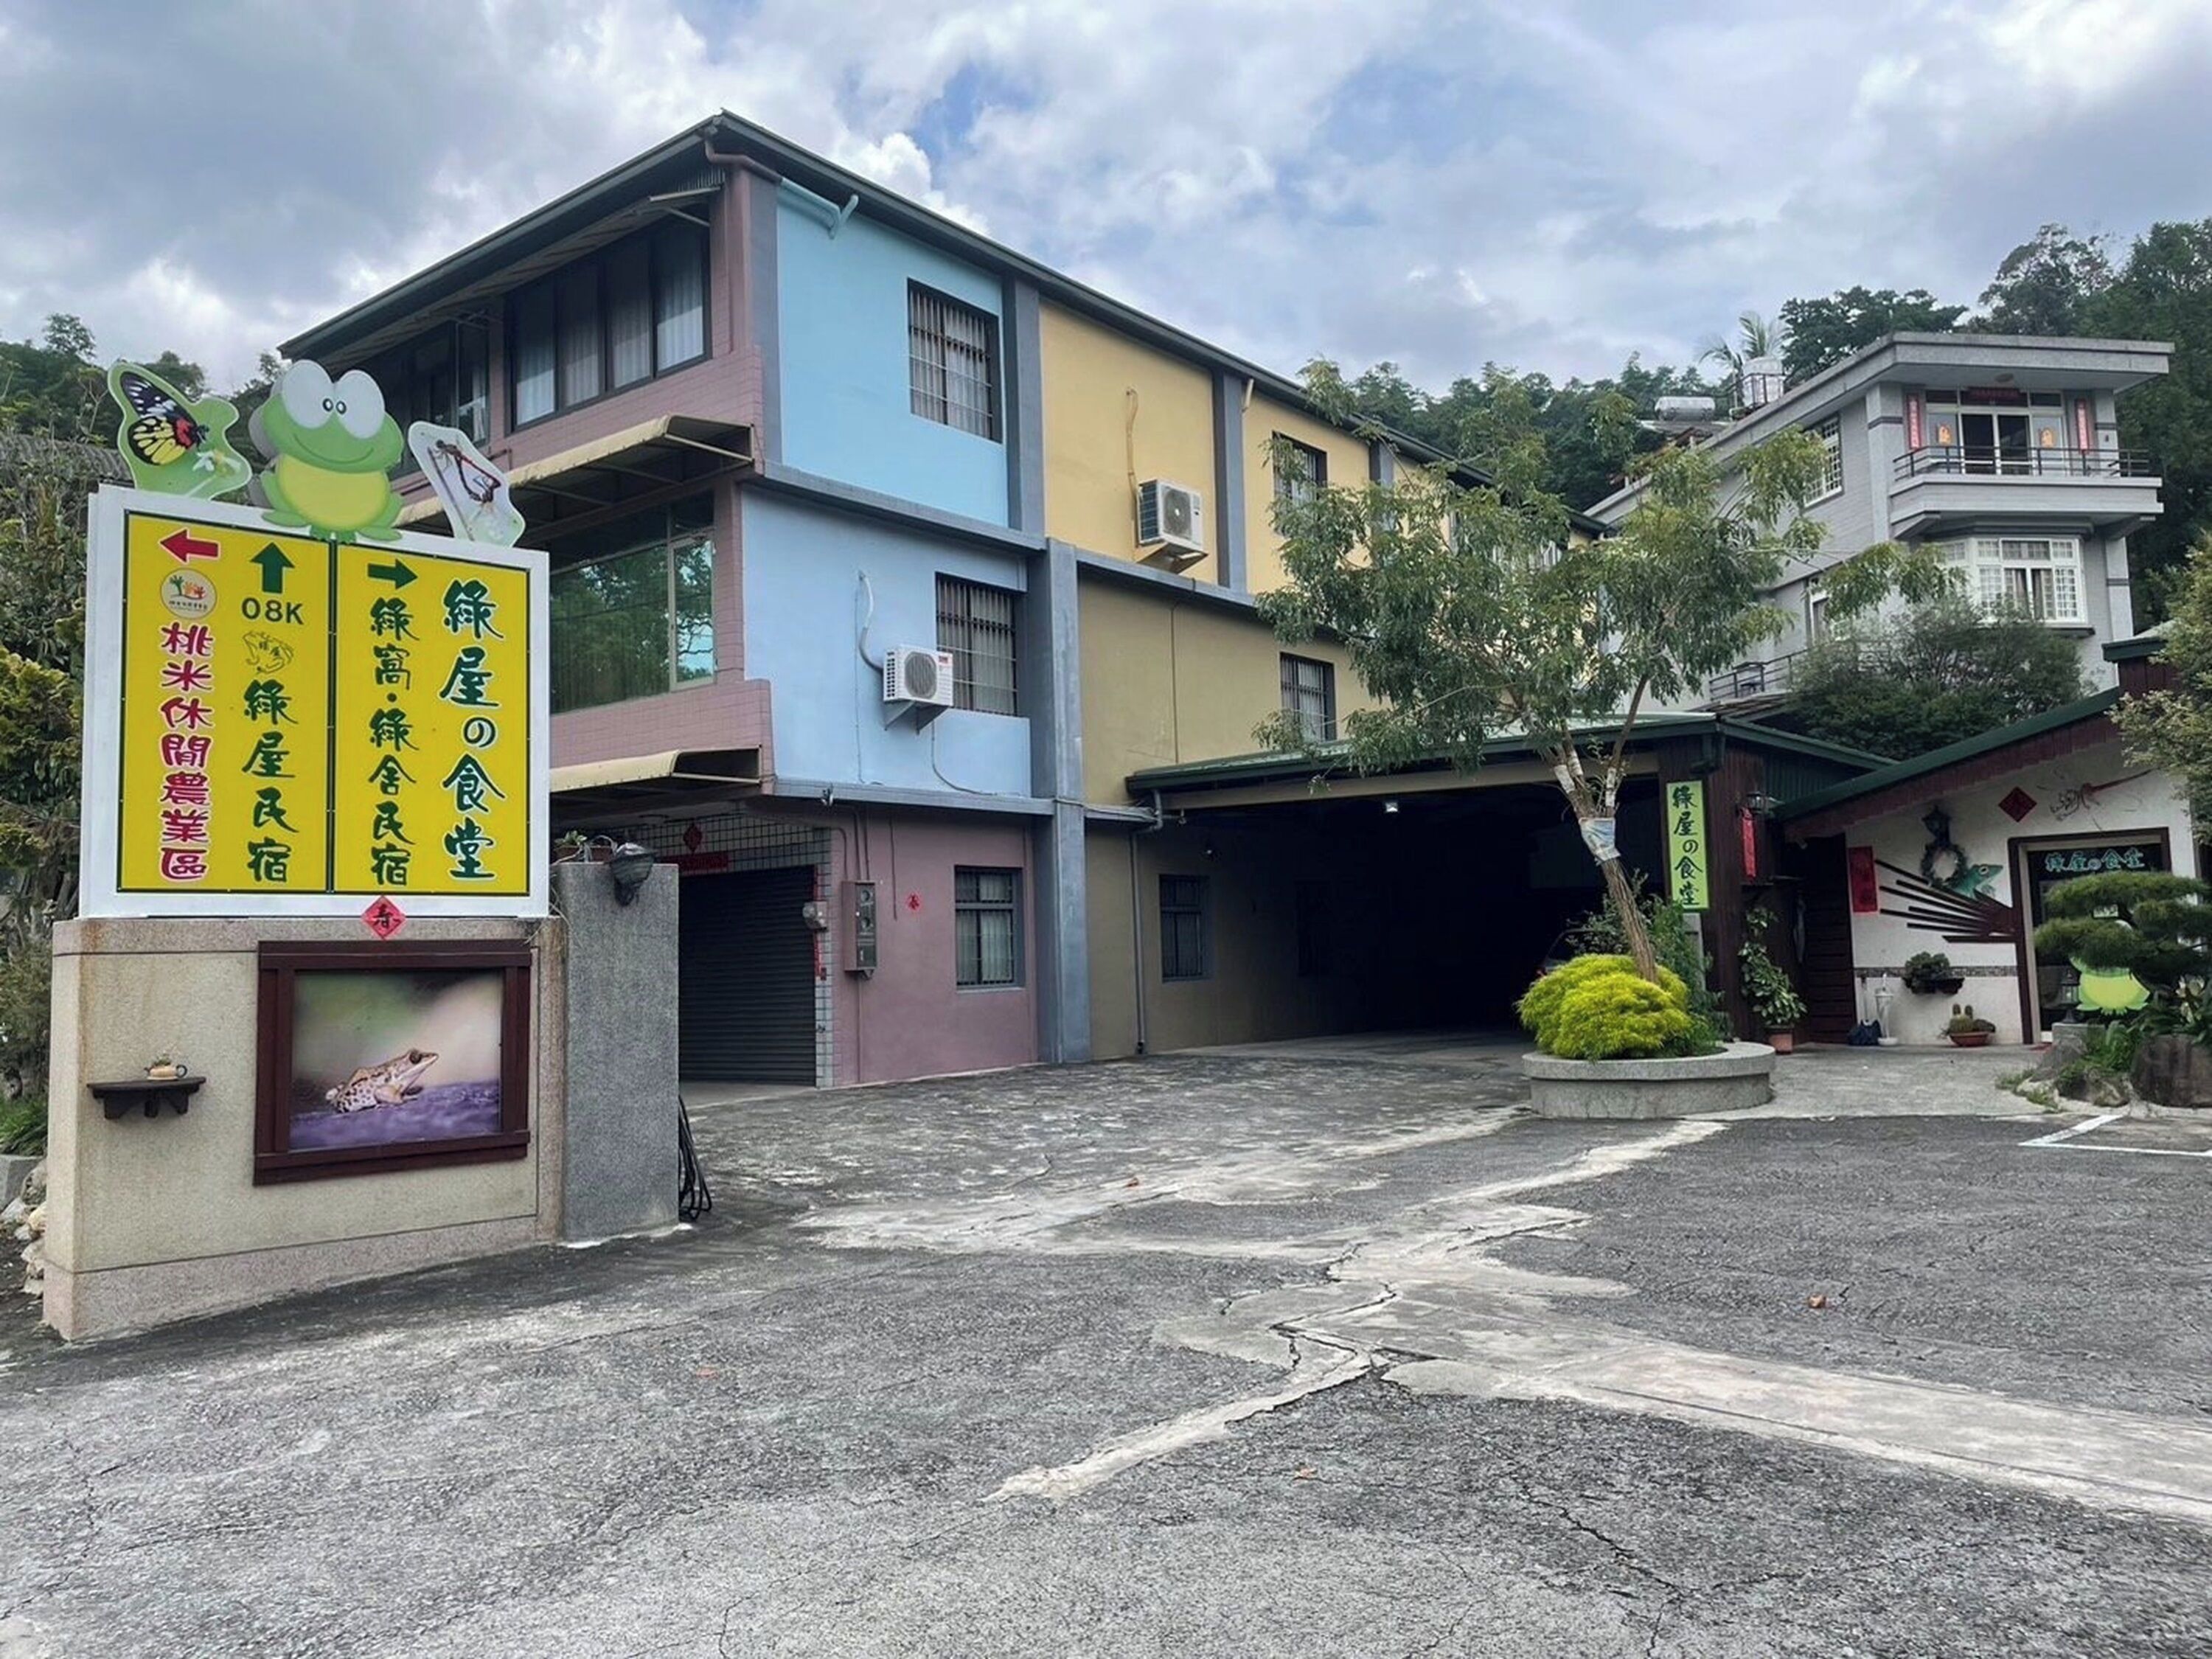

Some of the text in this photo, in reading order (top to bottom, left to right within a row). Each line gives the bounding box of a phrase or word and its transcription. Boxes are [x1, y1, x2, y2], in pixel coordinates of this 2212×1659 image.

[241, 597, 304, 625] 08K
[242, 679, 299, 883] 綠屋民宿
